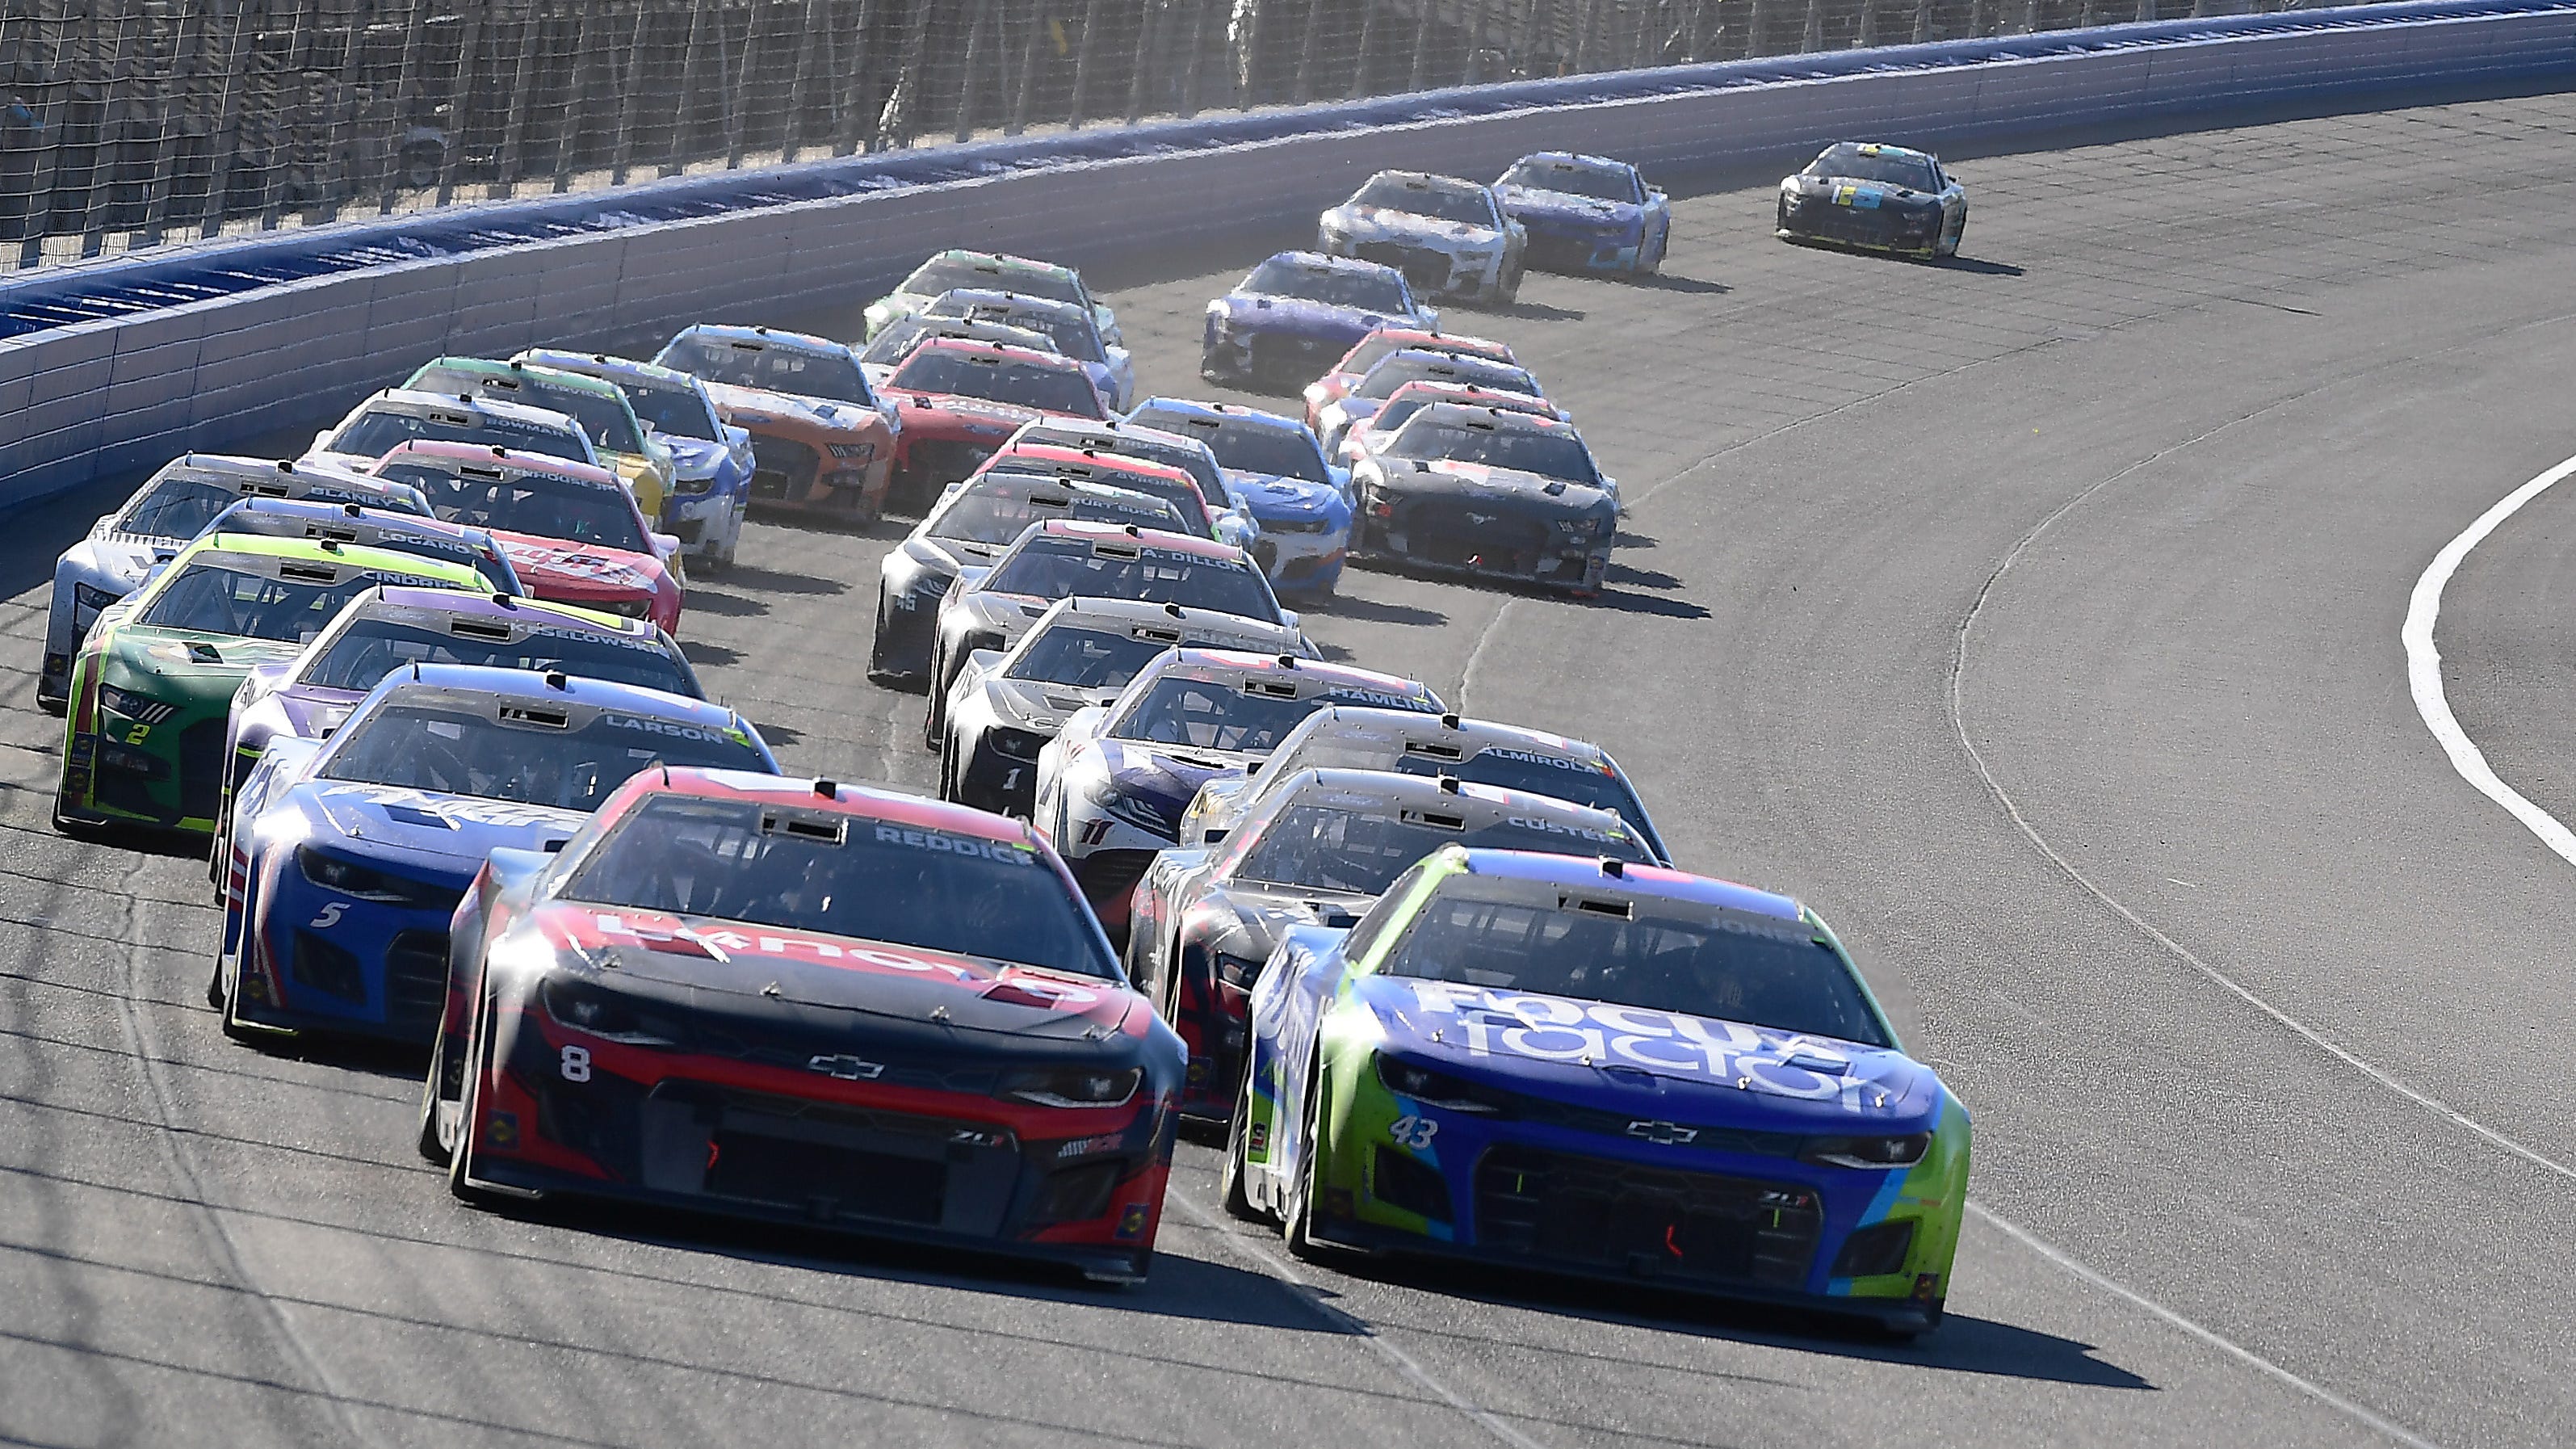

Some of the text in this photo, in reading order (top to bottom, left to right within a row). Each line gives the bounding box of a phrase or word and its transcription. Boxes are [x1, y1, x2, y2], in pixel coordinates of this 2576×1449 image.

[378, 529, 471, 554] LOGANO
[1142, 548, 1247, 573] A. DILLON
[1328, 687, 1436, 713] HAMLIN
[125, 724, 150, 746] 2
[606, 716, 724, 745] LARSON
[1479, 746, 1601, 775] ALMIROLA
[1002, 768, 1021, 790] 1
[1507, 817, 1617, 846] CUSTER
[875, 825, 1034, 866] REDDICK
[309, 902, 350, 928] 5
[561, 1044, 592, 1083] 8
[1389, 1115, 1439, 1149] 43
